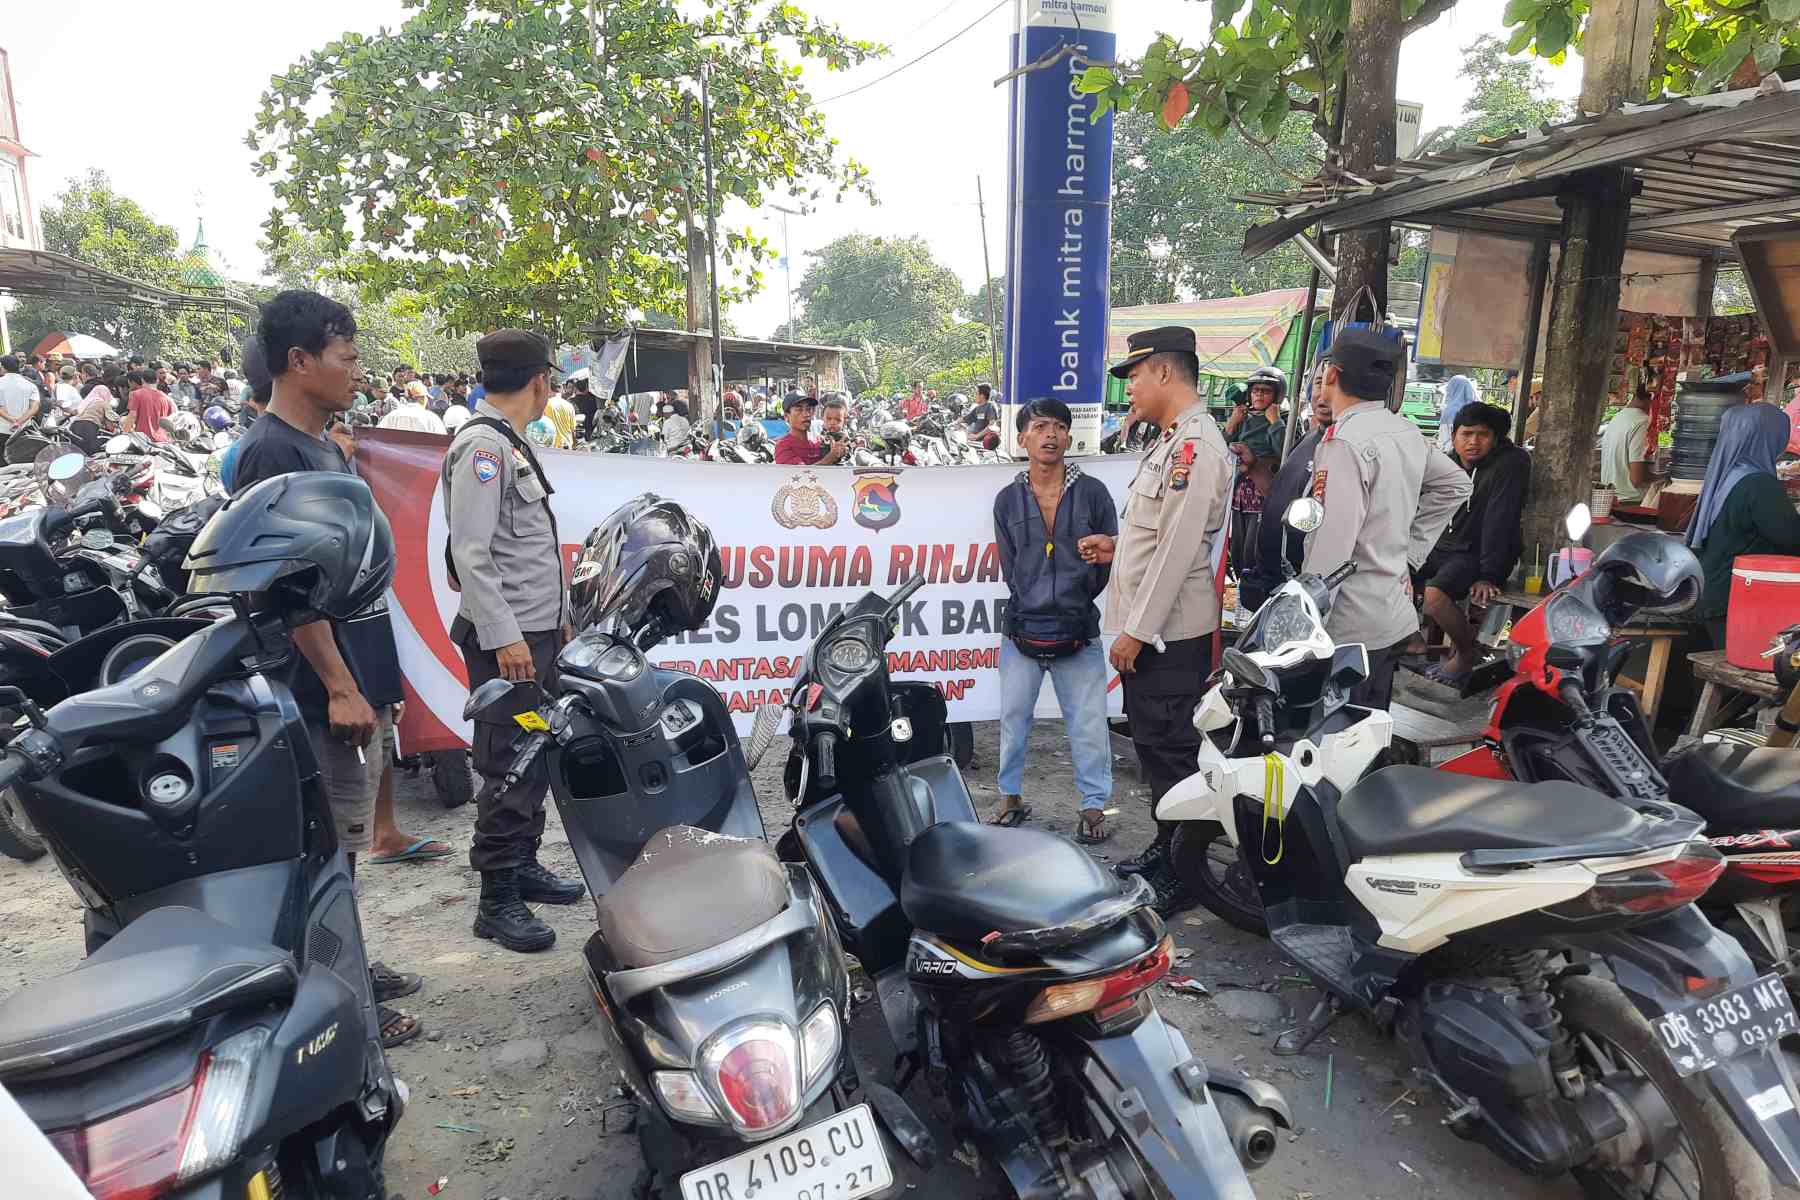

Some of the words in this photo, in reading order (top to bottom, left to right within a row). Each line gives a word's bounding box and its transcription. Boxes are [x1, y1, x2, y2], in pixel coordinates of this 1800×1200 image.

[1057, 208, 1083, 297] mitra
[1052, 308, 1080, 391] bank
[887, 543, 1008, 586] RINJA
[1418, 881, 1441, 889] 150
[914, 959, 957, 974] VARIO
[704, 980, 750, 1004] HONDA
[1696, 993, 1752, 1034] 3383
[1752, 979, 1785, 1012] MF
[695, 1171, 733, 1200] DR
[744, 1138, 817, 1190] 4109
[827, 1118, 864, 1157] CU
